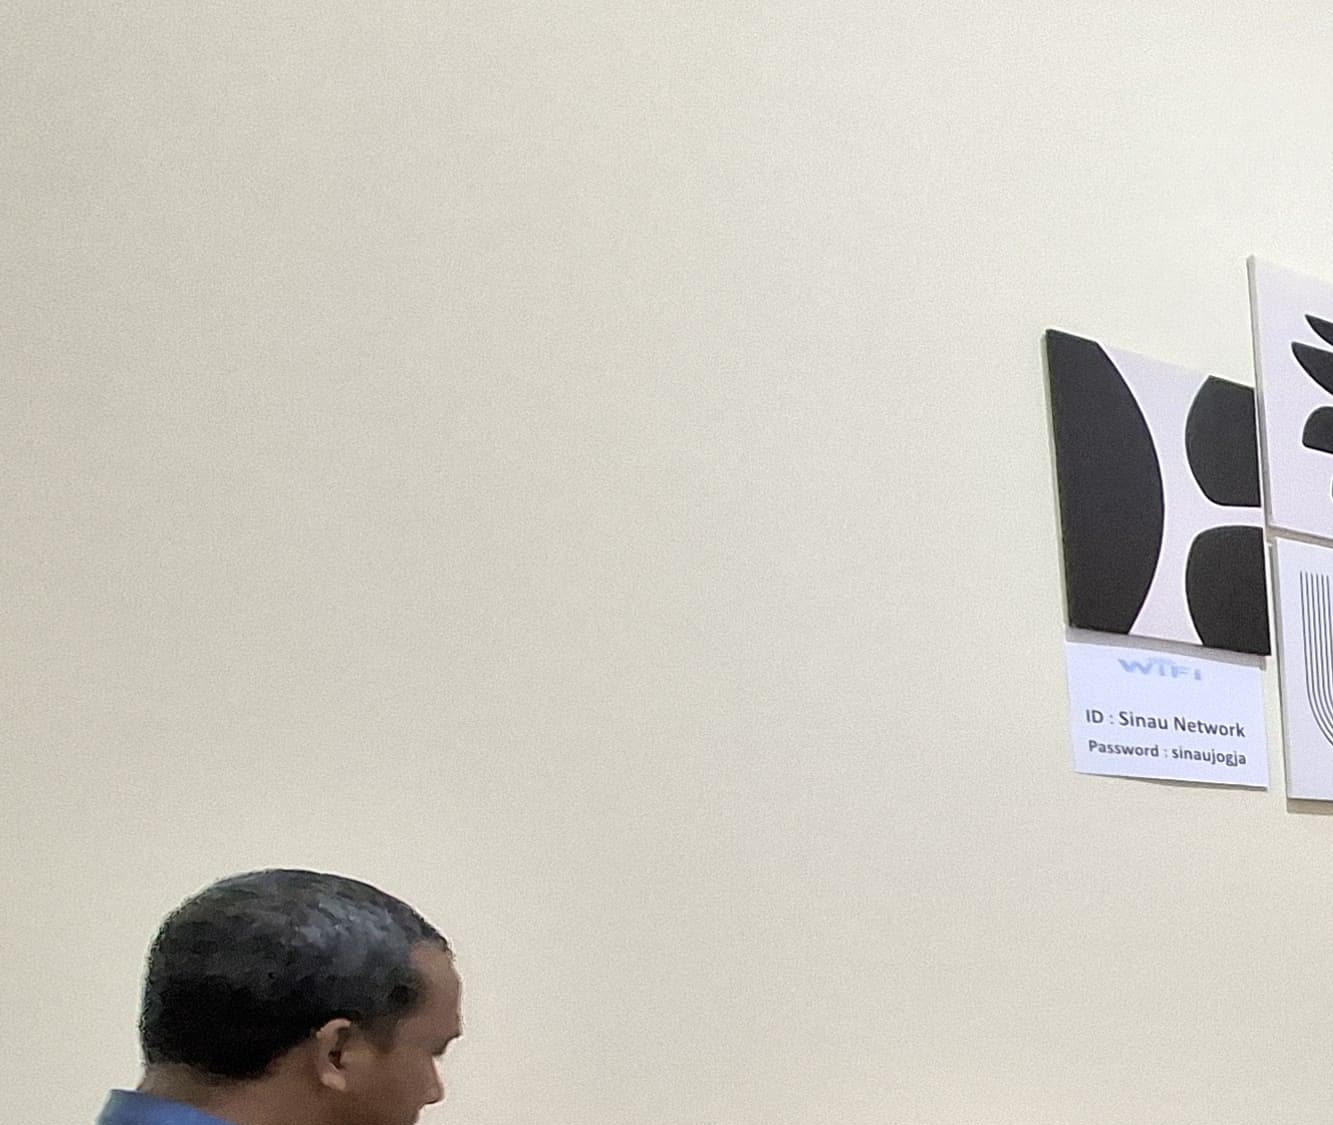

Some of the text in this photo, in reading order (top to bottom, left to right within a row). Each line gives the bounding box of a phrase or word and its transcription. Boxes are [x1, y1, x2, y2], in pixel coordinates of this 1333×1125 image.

[1086, 709, 1104, 724] ID
[1119, 711, 1168, 730] Sinau
[1175, 716, 1246, 737] Network
[1088, 740, 1159, 757] Password
[1172, 748, 1246, 767] sinaujogja
